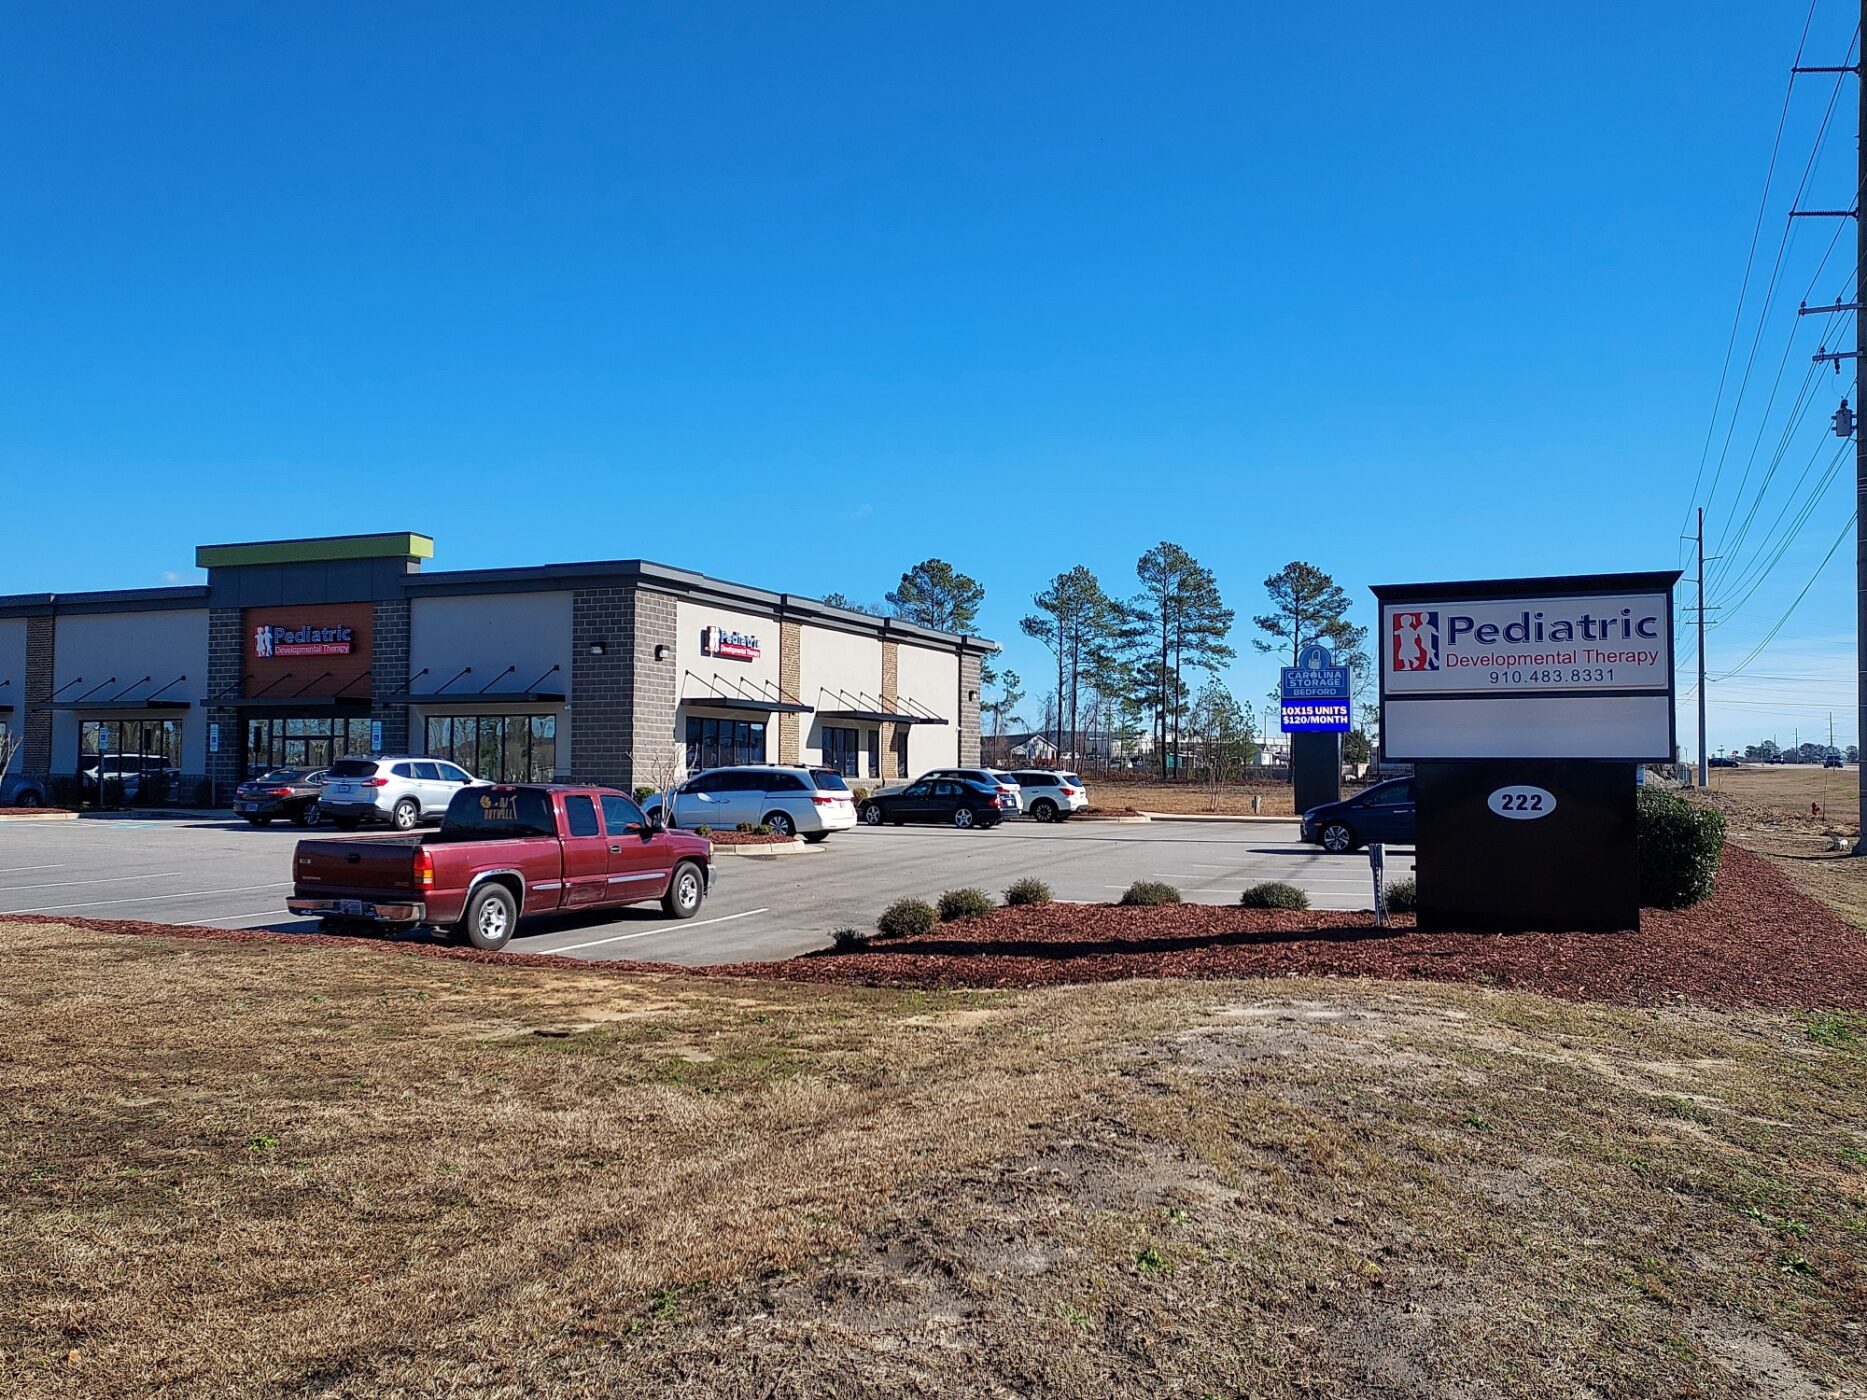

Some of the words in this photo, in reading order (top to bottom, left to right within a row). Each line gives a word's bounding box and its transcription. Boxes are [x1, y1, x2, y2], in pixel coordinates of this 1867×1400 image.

[1447, 608, 1659, 646] Pediatric
[274, 624, 352, 644] Pediatric
[275, 646, 321, 655] Developmental
[322, 644, 350, 654] Therapy
[1446, 650, 1577, 669] Developmental
[1582, 649, 1659, 666] Therapy
[1288, 671, 1342, 680] CAROLINA
[1489, 668, 1614, 683] 910.483.8331
[1289, 679, 1341, 687] STORAGE
[1293, 688, 1337, 696] BEDFORD
[1281, 706, 1314, 715] 10X15
[1315, 706, 1347, 715] UNITS
[1283, 715, 1348, 725] $120/MONTH
[1501, 793, 1543, 811] 222
